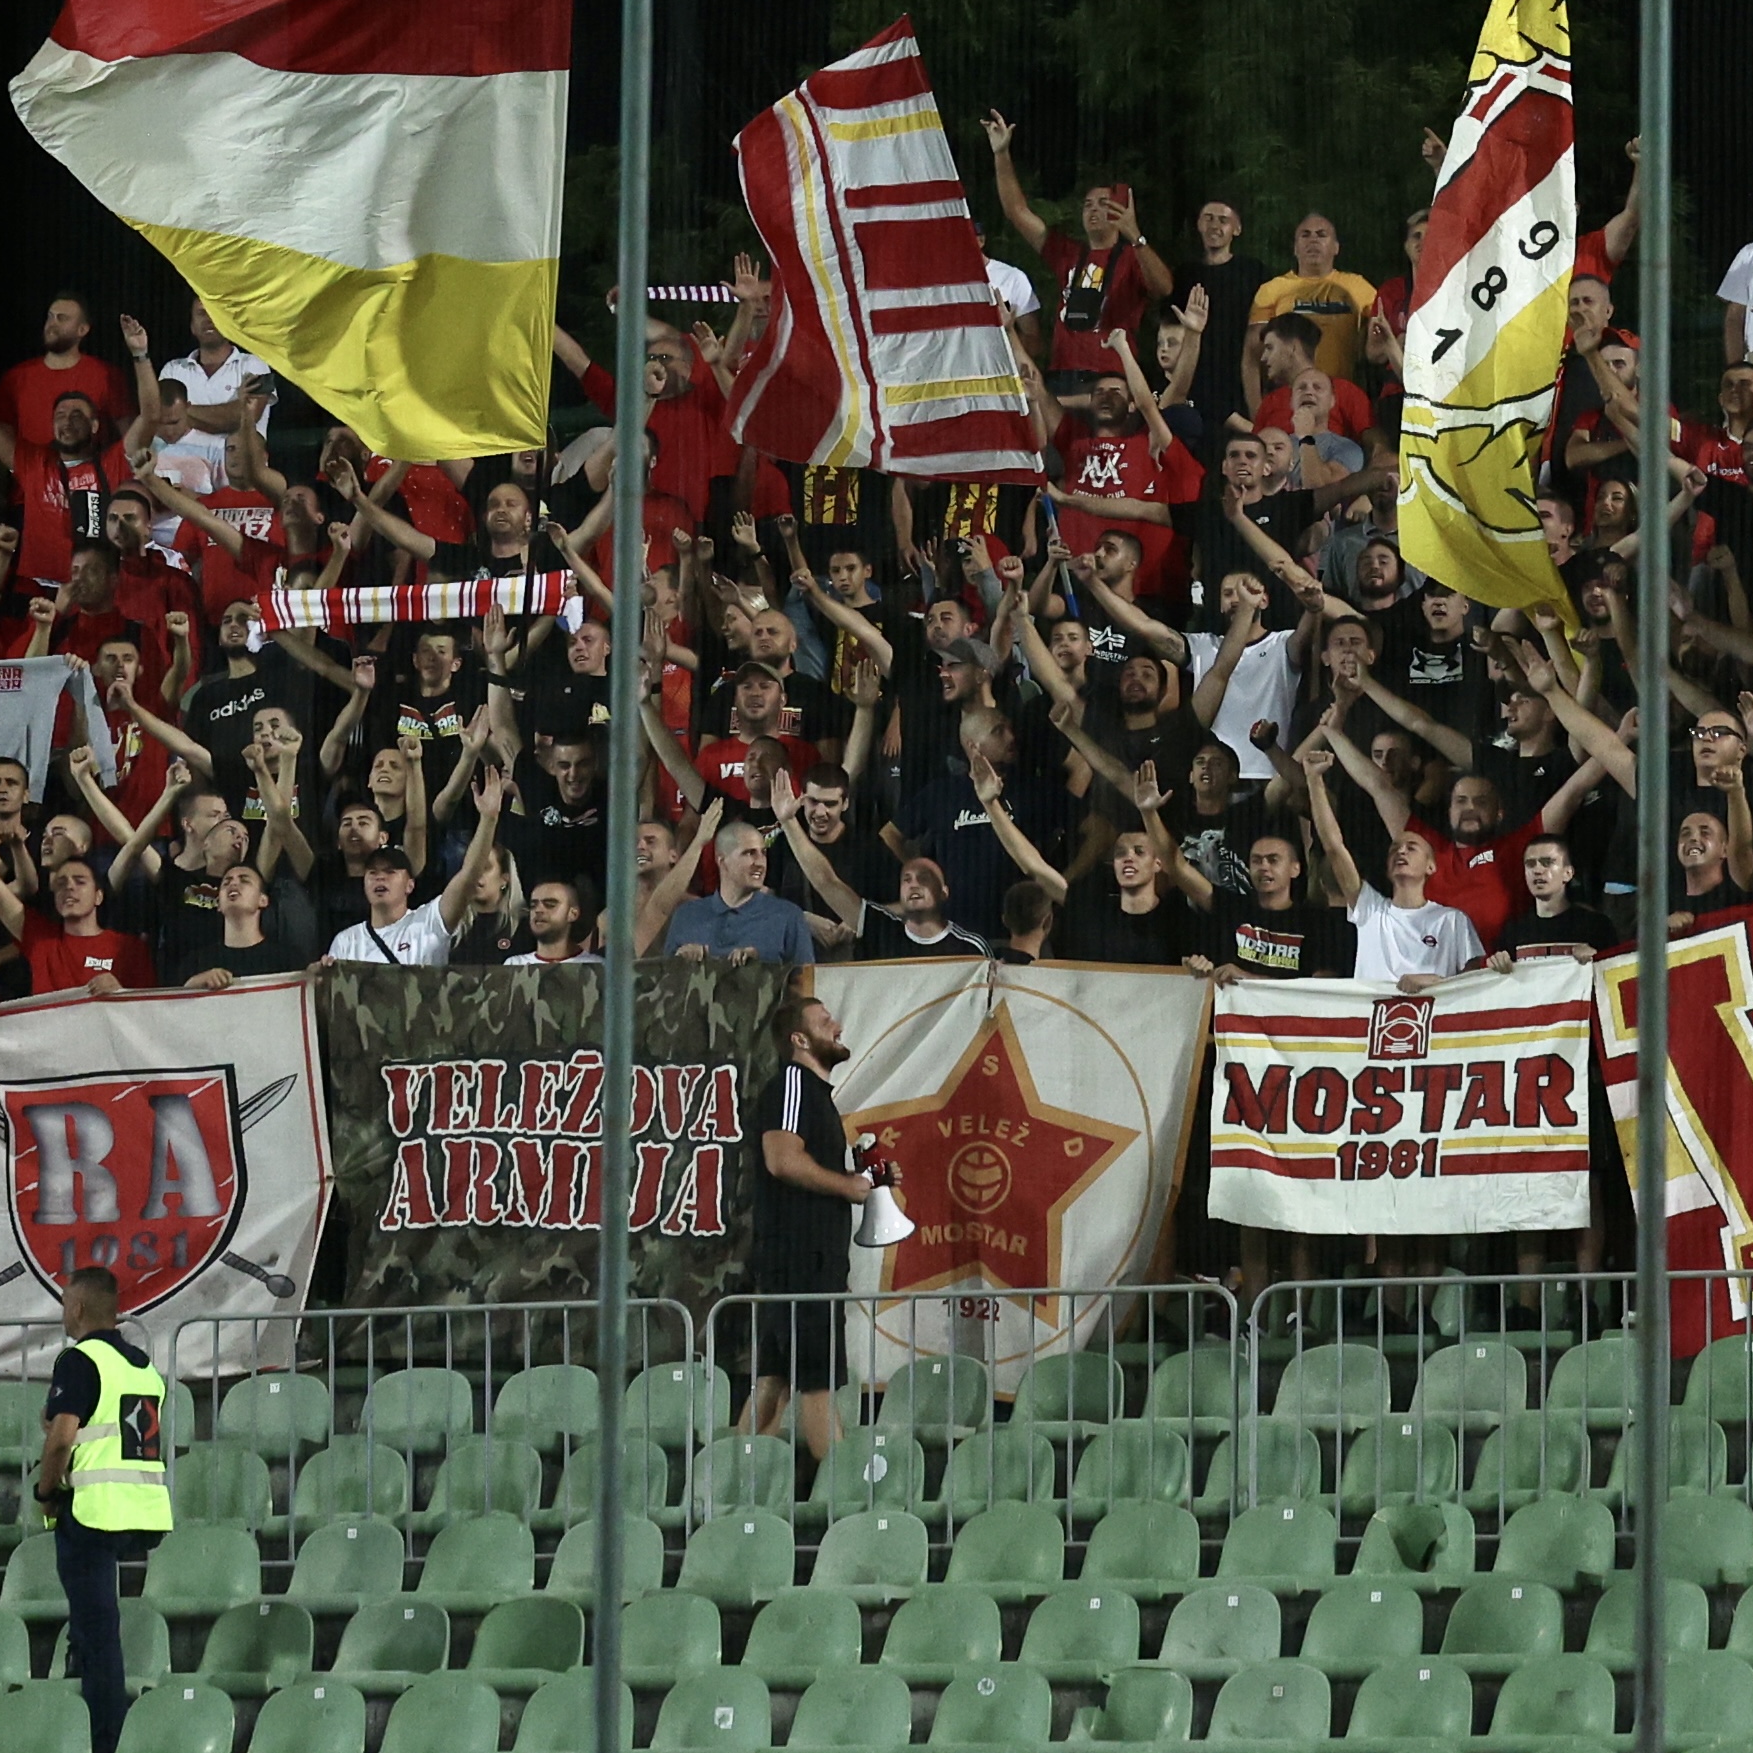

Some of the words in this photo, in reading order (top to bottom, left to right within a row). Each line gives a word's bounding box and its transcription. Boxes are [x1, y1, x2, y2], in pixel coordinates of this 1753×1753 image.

[210, 687, 266, 722] adidas
[1222, 1052, 1580, 1136] MOSTAR
[936, 1114, 1030, 1150] VELEŽ
[1334, 1139, 1440, 1182] 1981
[920, 1222, 1029, 1258] MOSTAR
